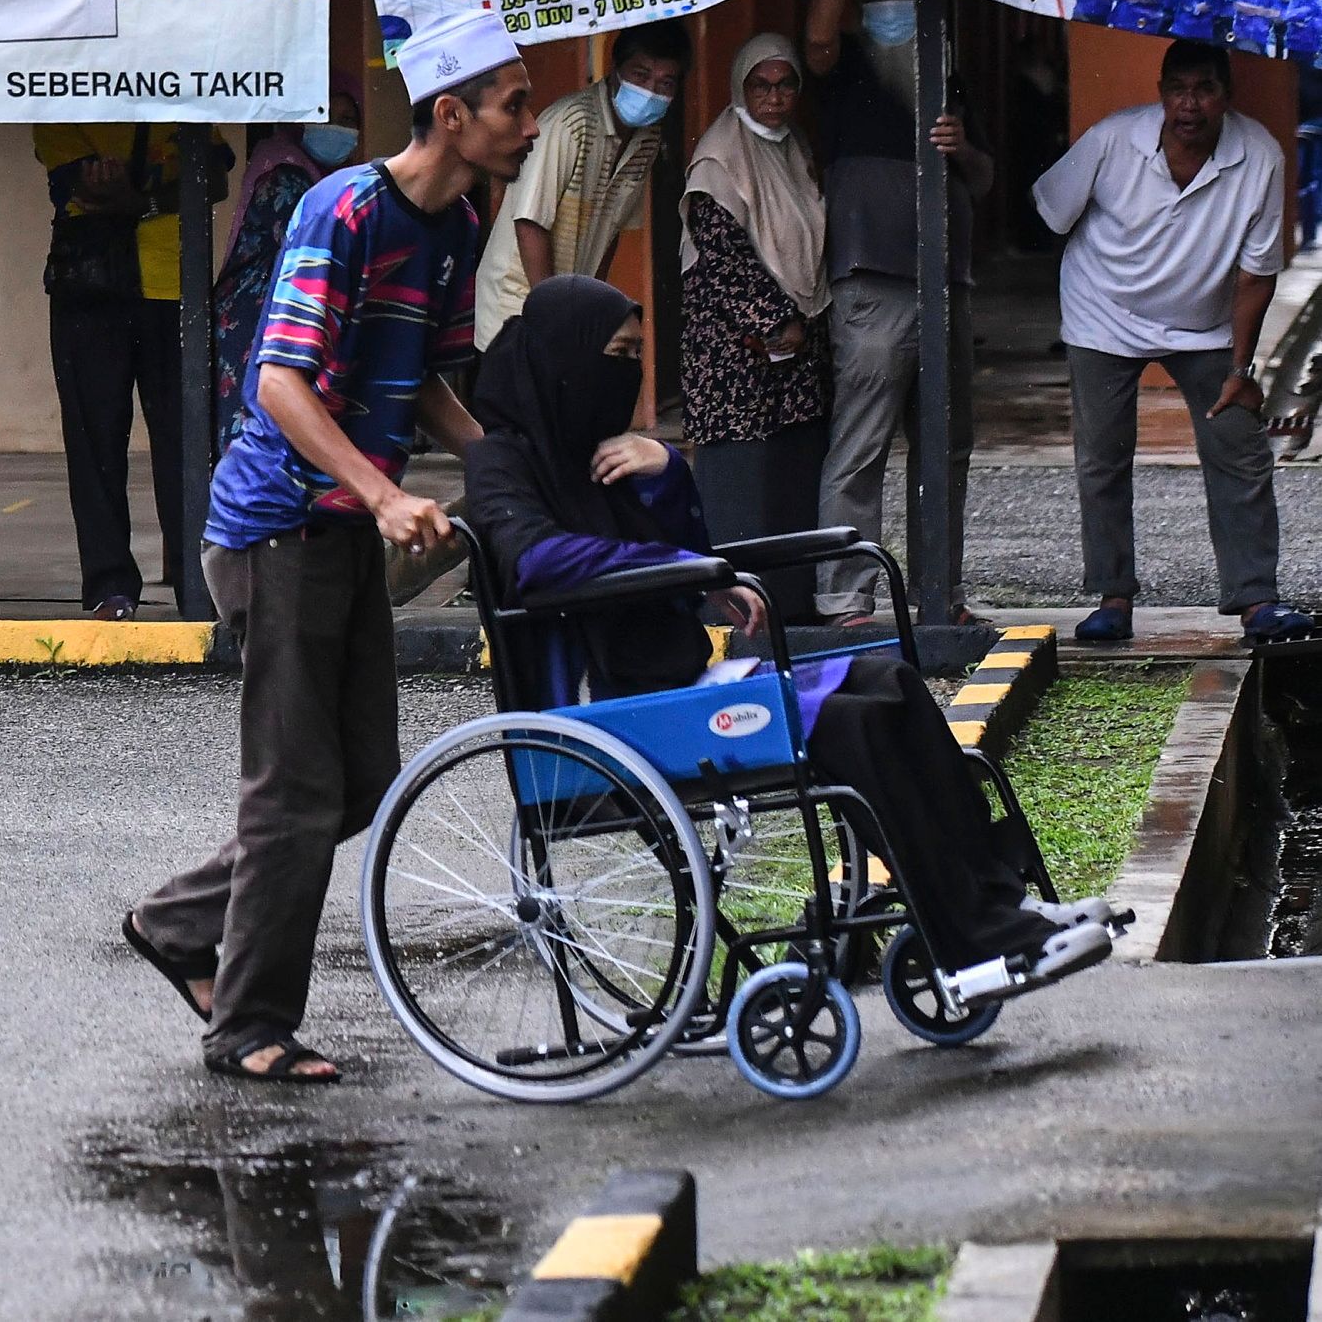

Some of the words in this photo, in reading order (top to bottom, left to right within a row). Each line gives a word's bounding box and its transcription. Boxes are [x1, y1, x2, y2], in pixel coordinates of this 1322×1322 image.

[504, 14, 532, 33] 20
[536, 6, 573, 28] NOV
[7, 72, 182, 98] SEBERANG
[190, 71, 285, 98] TAKIR
